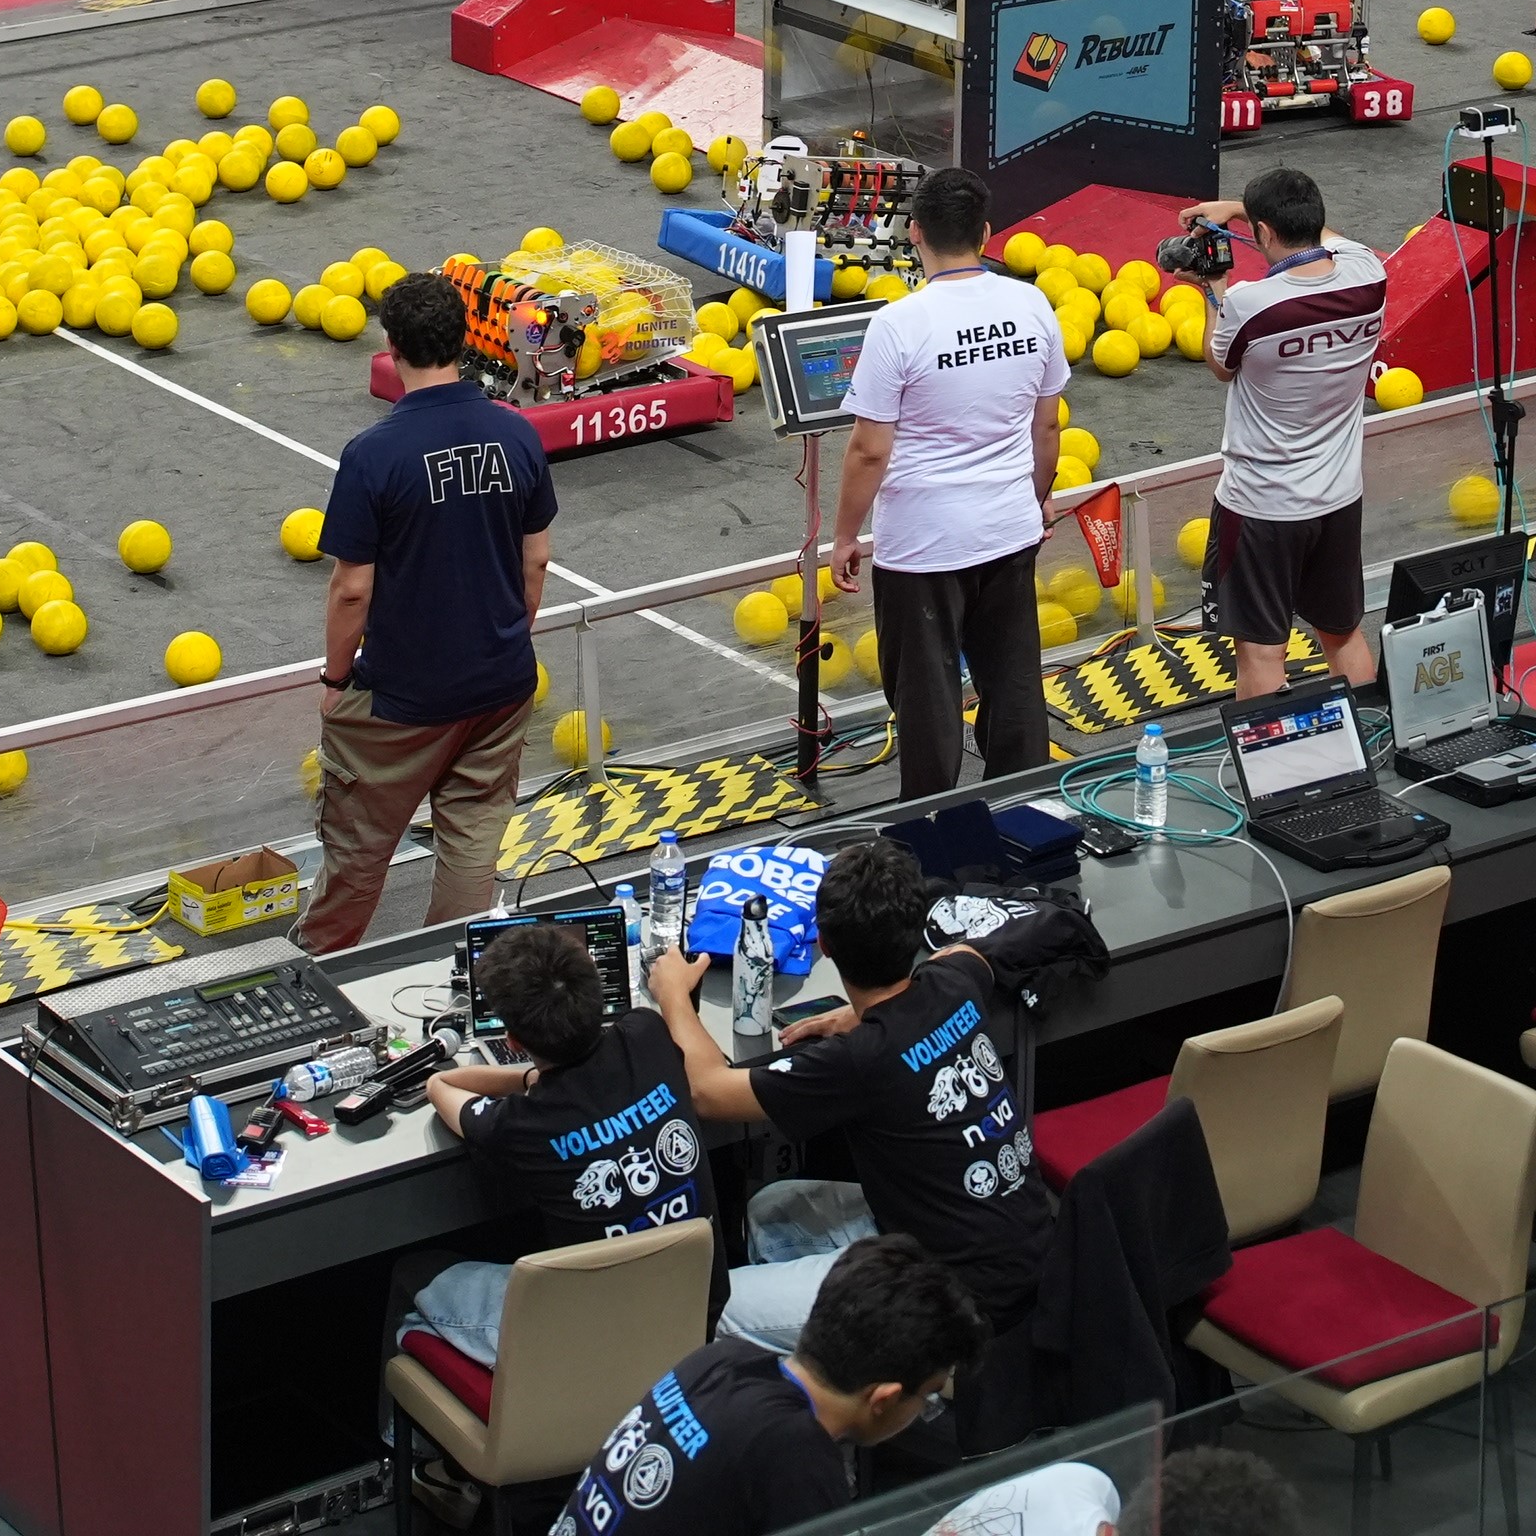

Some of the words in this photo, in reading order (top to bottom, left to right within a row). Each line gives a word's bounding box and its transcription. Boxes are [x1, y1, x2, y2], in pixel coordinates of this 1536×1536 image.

[1074, 23, 1176, 70] REBUILT
[1363, 89, 1403, 119] 38
[716, 242, 767, 290] 11416
[625, 335, 687, 352] ROBOTICS
[636, 319, 678, 334] IGNITE
[956, 320, 1017, 346] HEAD
[937, 337, 1039, 371] REFEREE
[570, 399, 669, 446] 11365
[423, 442, 513, 504] FTA
[1083, 514, 1110, 573] COMPETITION
[1093, 518, 1114, 563] ROBOTICS
[1104, 520, 1118, 550] FIRST
[1422, 642, 1446, 659] FIRST
[1414, 651, 1465, 695] AGE
[901, 999, 982, 1074] VOLUNTEER
[549, 1082, 678, 1161] VOLUNTEER
